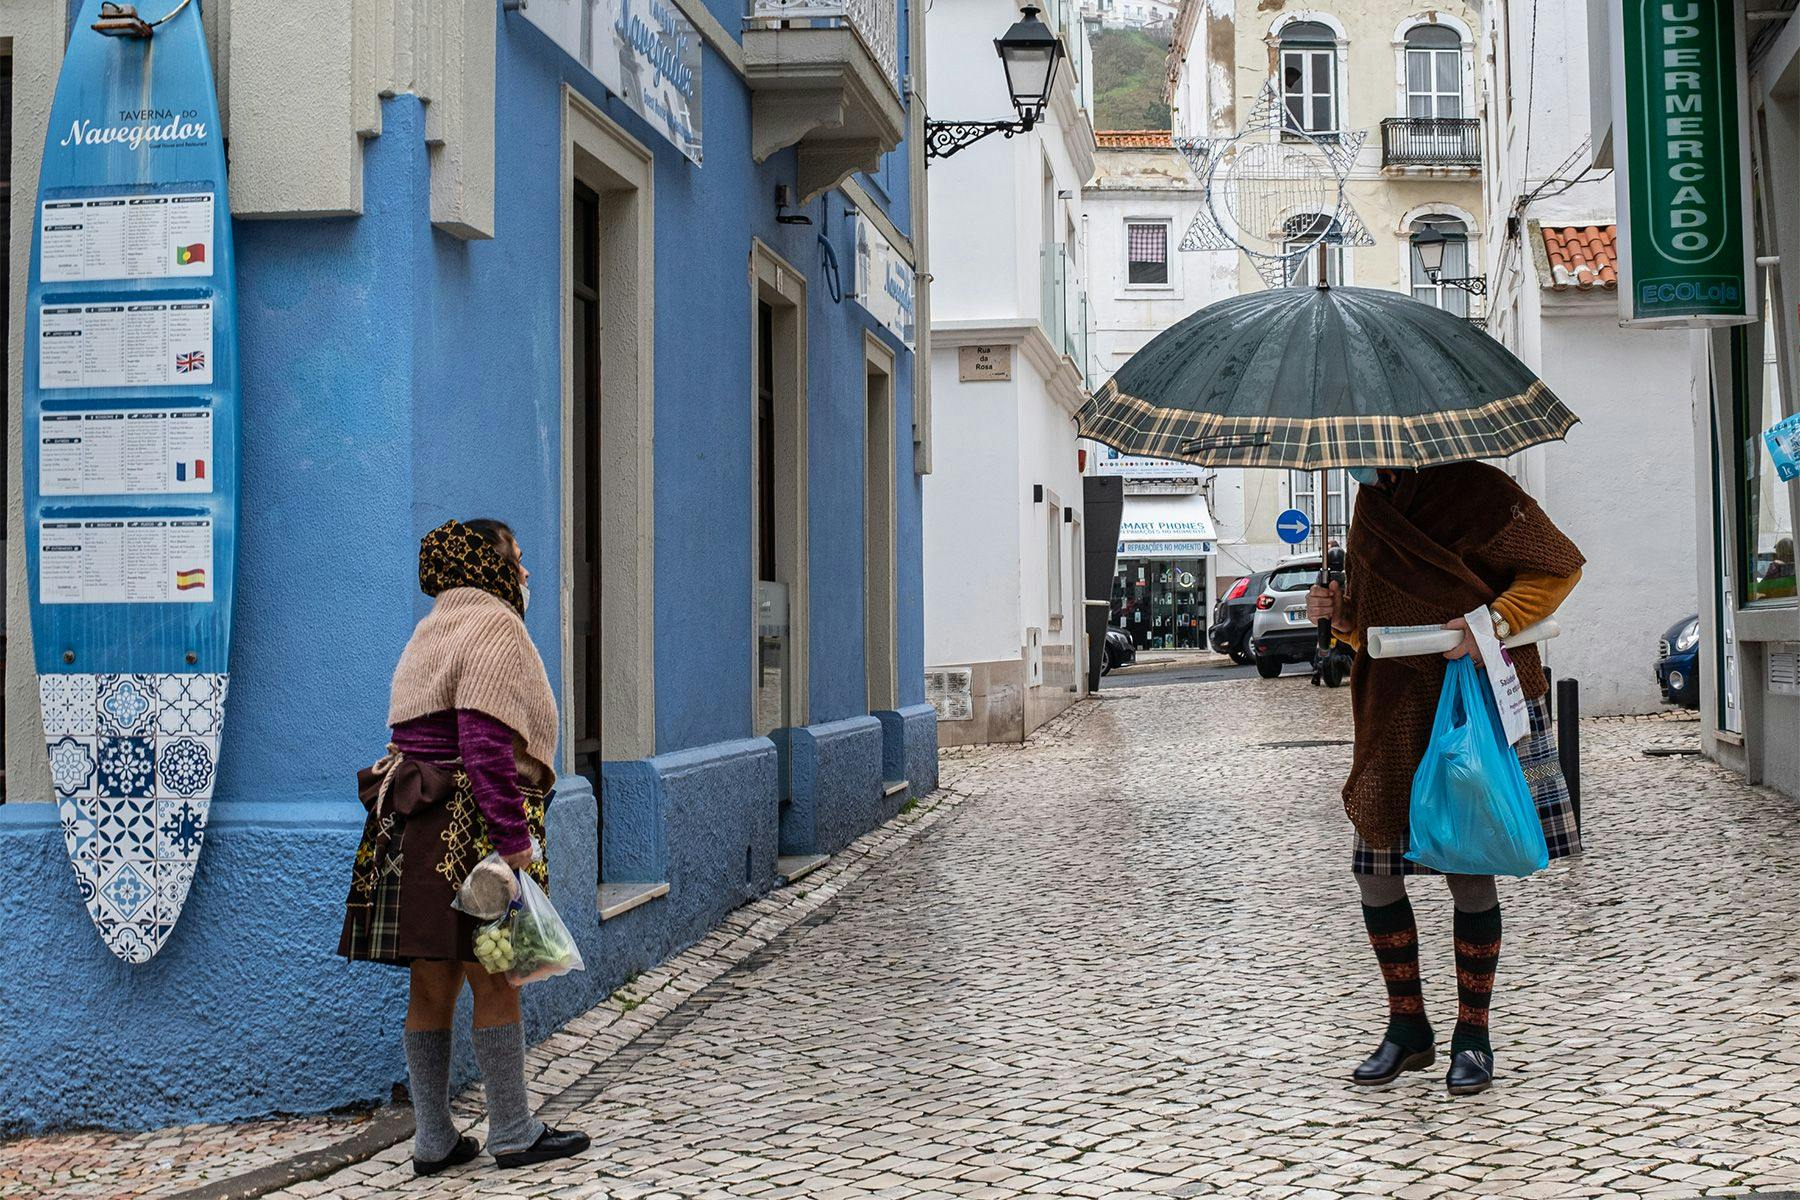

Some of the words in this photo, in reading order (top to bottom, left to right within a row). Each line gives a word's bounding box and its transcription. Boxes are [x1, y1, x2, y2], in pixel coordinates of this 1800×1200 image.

[119, 109, 173, 121] TAVERNA
[182, 109, 198, 119] DO
[60, 115, 208, 151] Navegador
[1642, 281, 1738, 305] ECOLoja
[1158, 522, 1205, 530] PHONES
[1127, 542, 1163, 553] REPARAÇÕES
[1164, 543, 1173, 552] NO
[1173, 543, 1202, 552] MOMENTO
